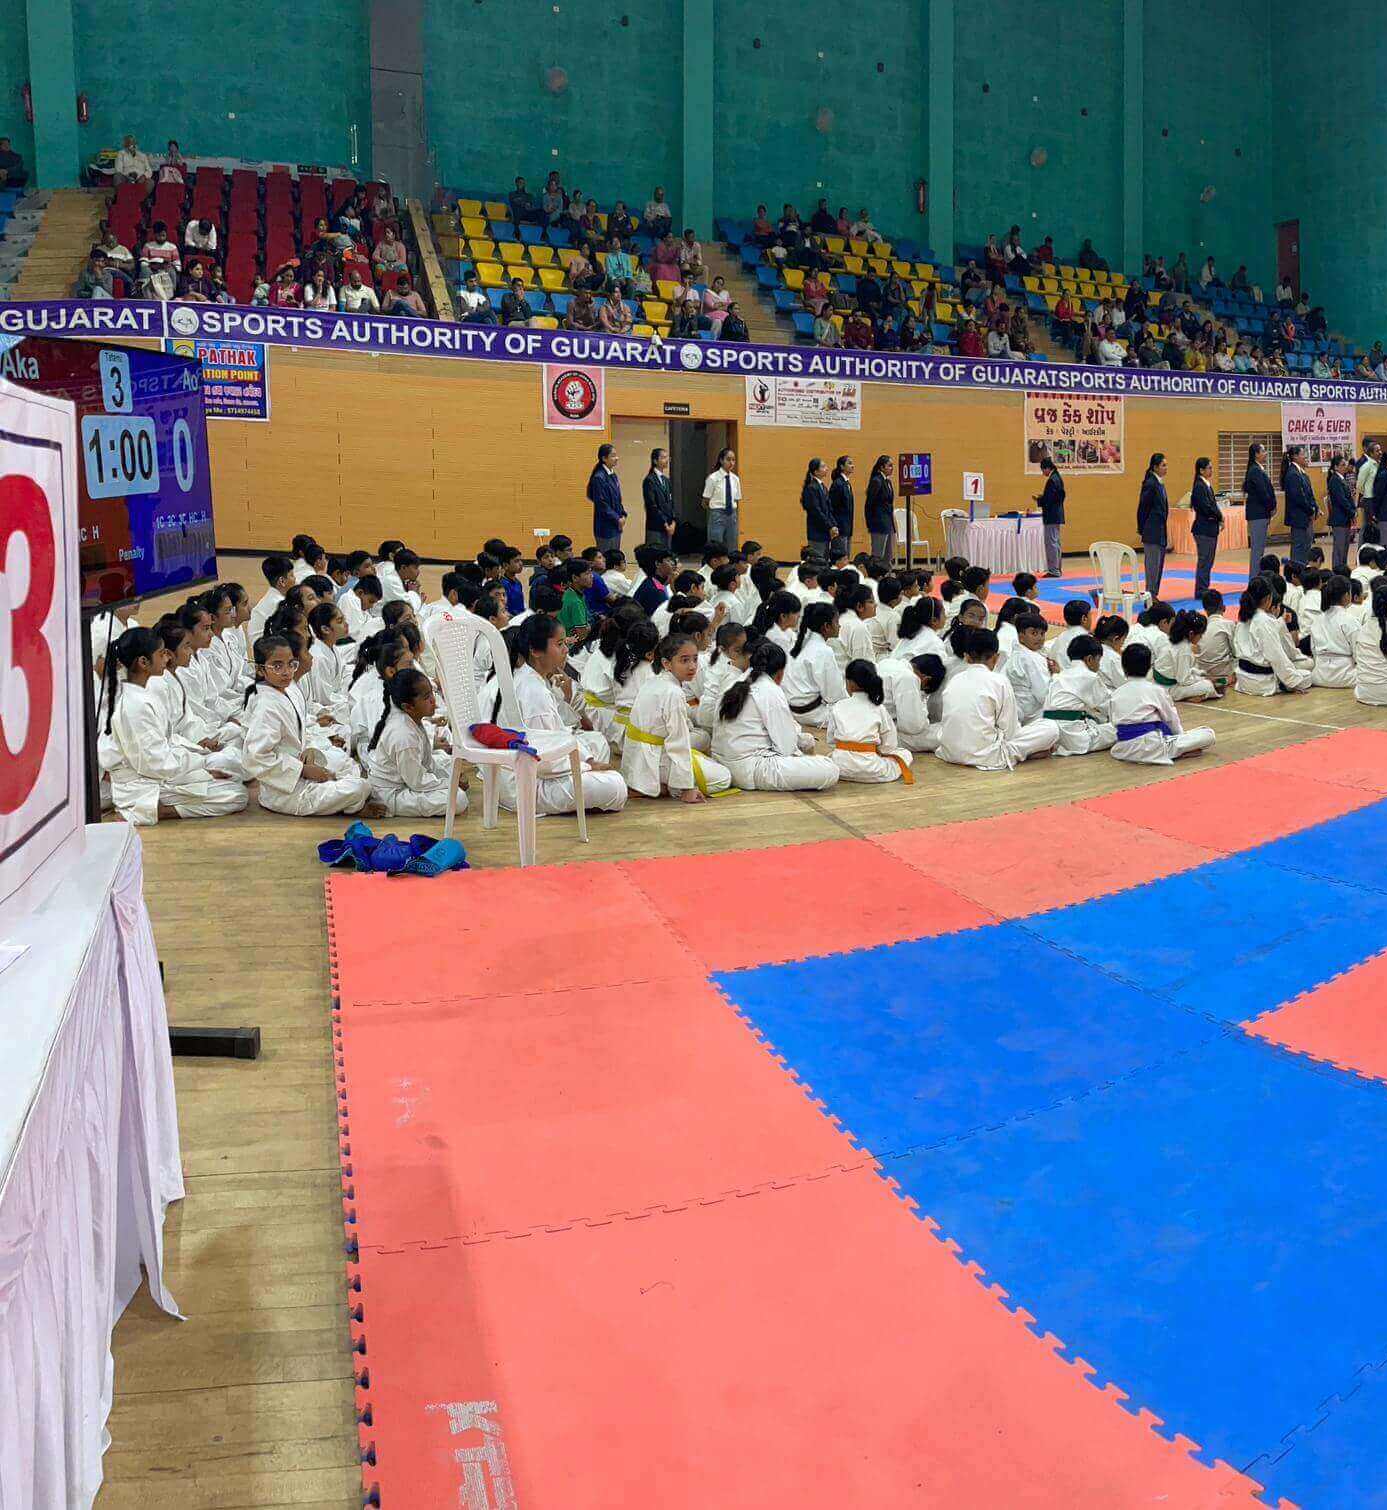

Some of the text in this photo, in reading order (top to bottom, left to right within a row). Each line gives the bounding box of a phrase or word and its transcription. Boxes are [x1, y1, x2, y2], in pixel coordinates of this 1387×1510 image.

[0, 308, 156, 331] GUJARAT
[202, 312, 676, 365] SPORTS AUTHORITY OF GUJARAT
[2, 349, 40, 380] Aka
[198, 348, 257, 366] PATHAK
[231, 369, 260, 381] POINT
[706, 347, 802, 373] SPORTS
[809, 354, 935, 380] AUTHORITY
[937, 363, 966, 382] OF
[1130, 377, 1214, 394] AUTHORITY
[1217, 379, 1236, 395] OF
[1239, 380, 1298, 397] GUJARAT
[110, 366, 124, 408] 3
[1311, 385, 1356, 400] SPORTS
[1062, 402, 1082, 424] કેક
[1086, 403, 1116, 425] શોપ
[1287, 420, 1351, 433] CAKE 4 EVER
[89, 428, 154, 484] 1:00
[172, 418, 195, 493] 0
[971, 478, 979, 495] 1
[0, 474, 56, 816] 3
